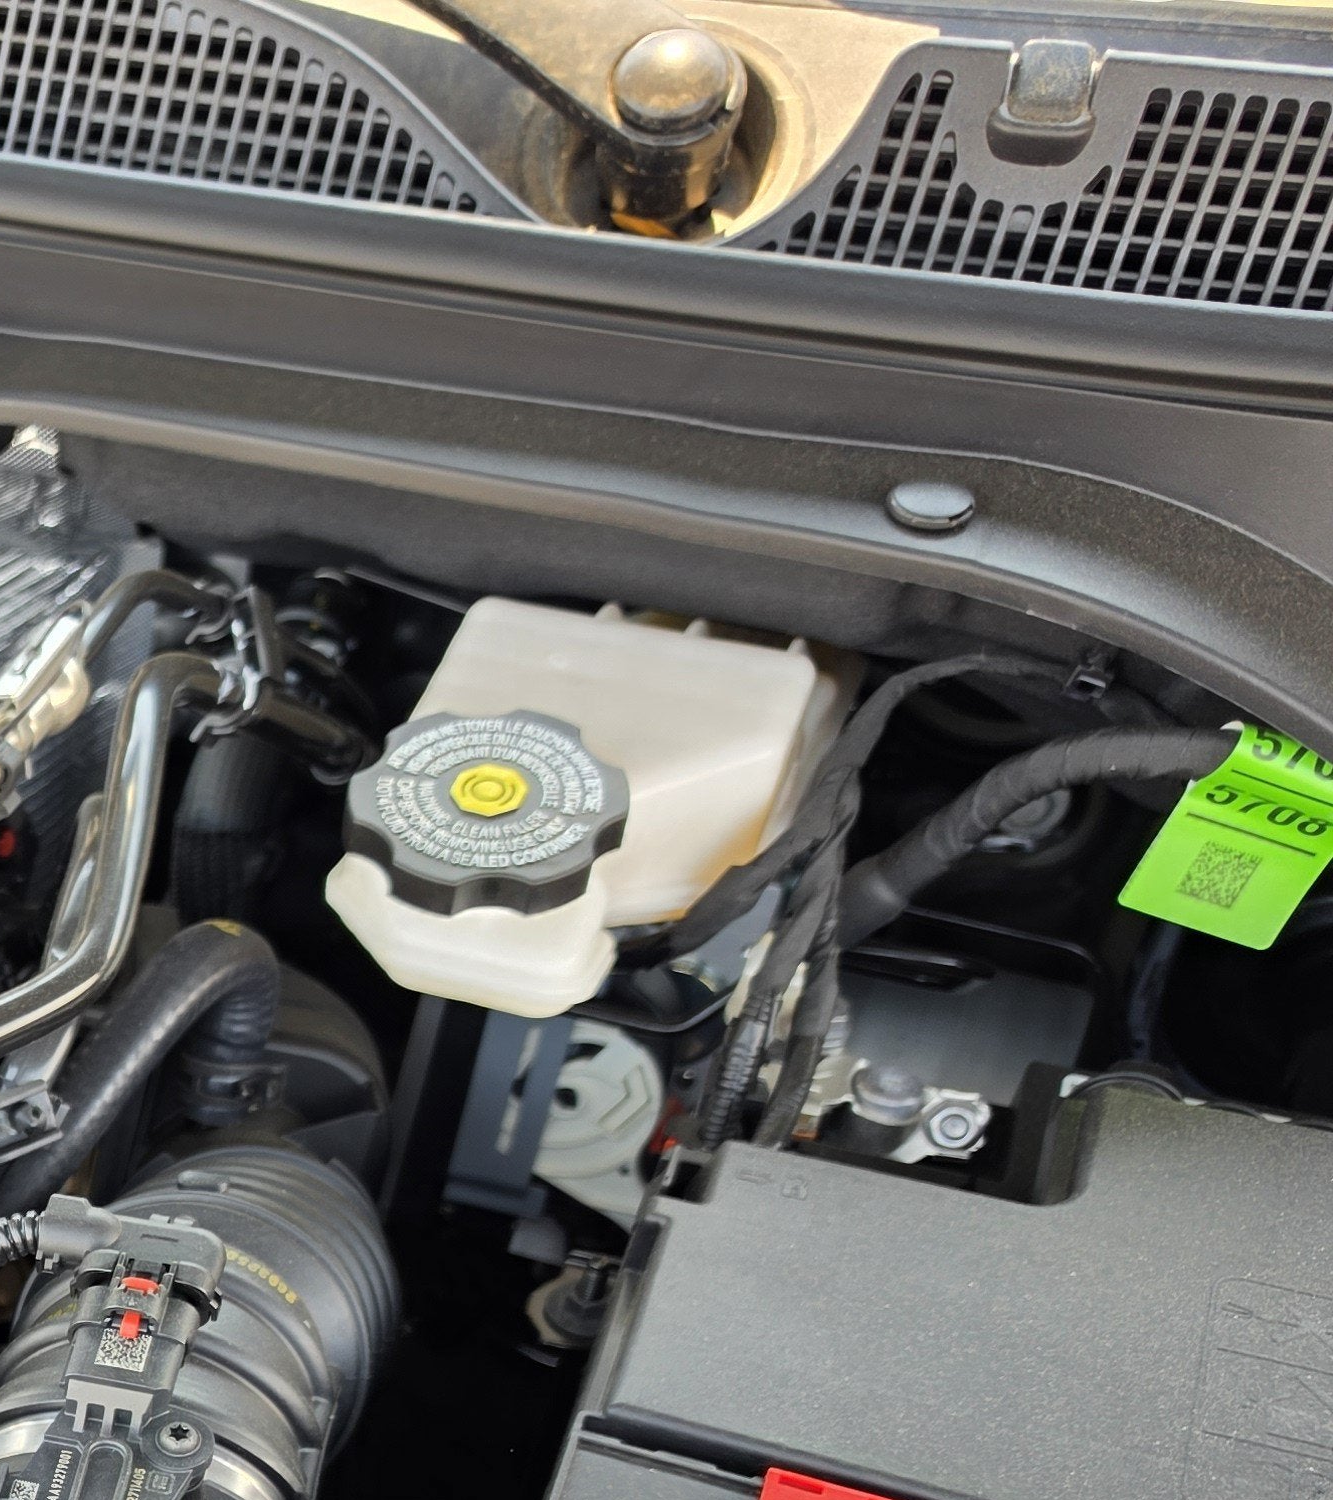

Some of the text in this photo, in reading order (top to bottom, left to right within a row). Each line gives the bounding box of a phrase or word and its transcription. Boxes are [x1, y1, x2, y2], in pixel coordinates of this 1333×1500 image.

[451, 820, 501, 840] CLEAN
[503, 810, 549, 837] FILLER
[1205, 784, 1333, 837] 5708
[451, 851, 511, 867] SEALED
